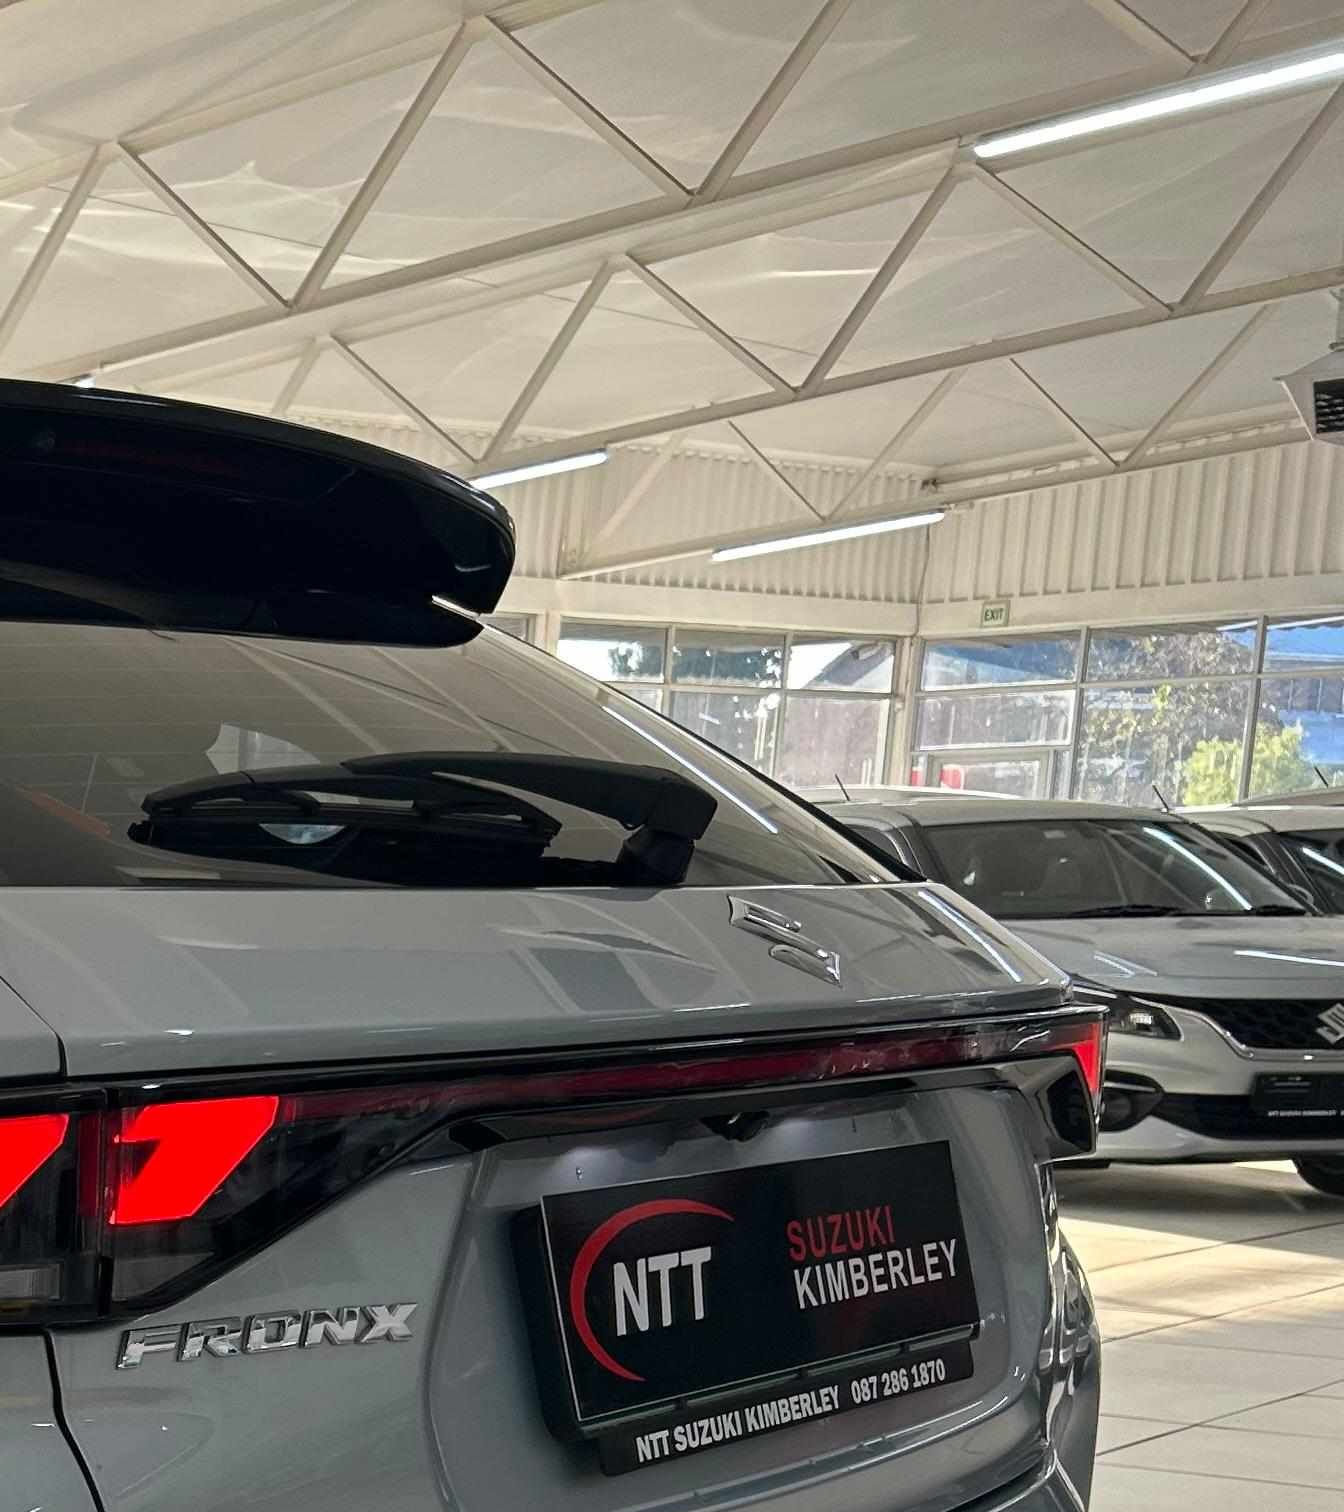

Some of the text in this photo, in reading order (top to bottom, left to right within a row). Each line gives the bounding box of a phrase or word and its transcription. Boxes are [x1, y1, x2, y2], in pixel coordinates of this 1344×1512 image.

[984, 607, 1004, 622] EXIT
[785, 1204, 897, 1263] SUZUKI
[611, 1246, 714, 1337] NTT
[792, 1238, 960, 1310] KIMBERLEY
[116, 1301, 419, 1370] FRONX
[635, 1358, 946, 1463] NTT SUZUKI KIMBERLEY 087 286 1870
